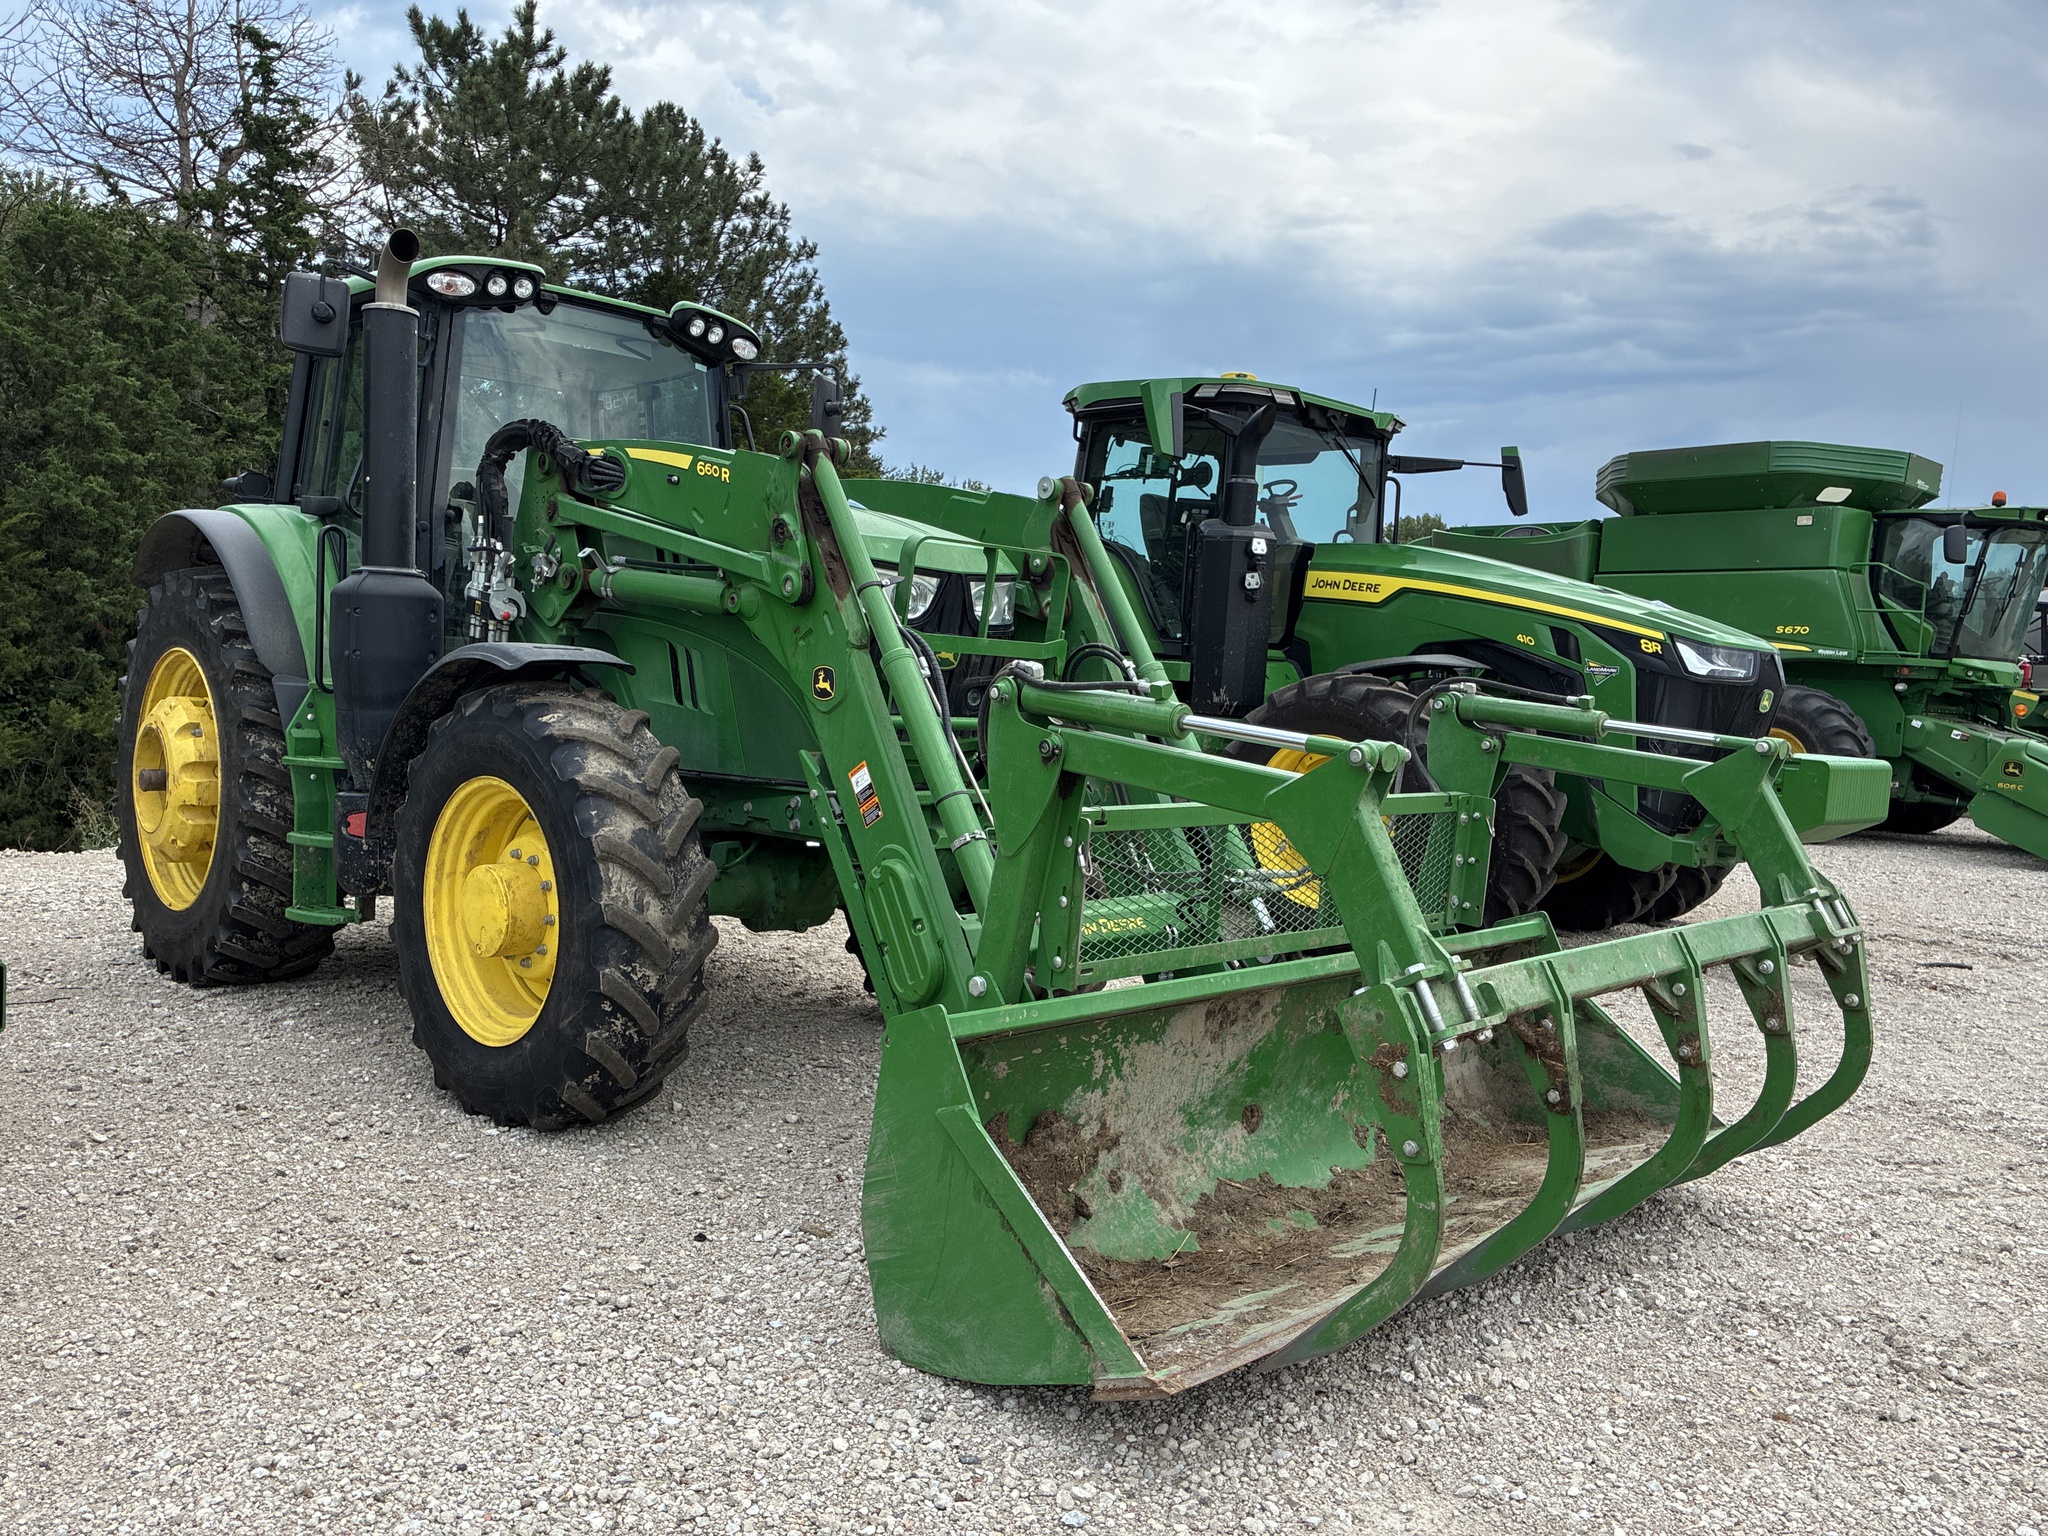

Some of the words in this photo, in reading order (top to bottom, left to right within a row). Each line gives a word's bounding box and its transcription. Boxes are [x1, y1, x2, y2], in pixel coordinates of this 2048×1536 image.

[1311, 577, 1341, 591] JOHN
[1342, 579, 1381, 594] DEERE
[1775, 625, 1810, 635] S670
[1516, 633, 1535, 647] 410
[1639, 638, 1664, 655] 8R
